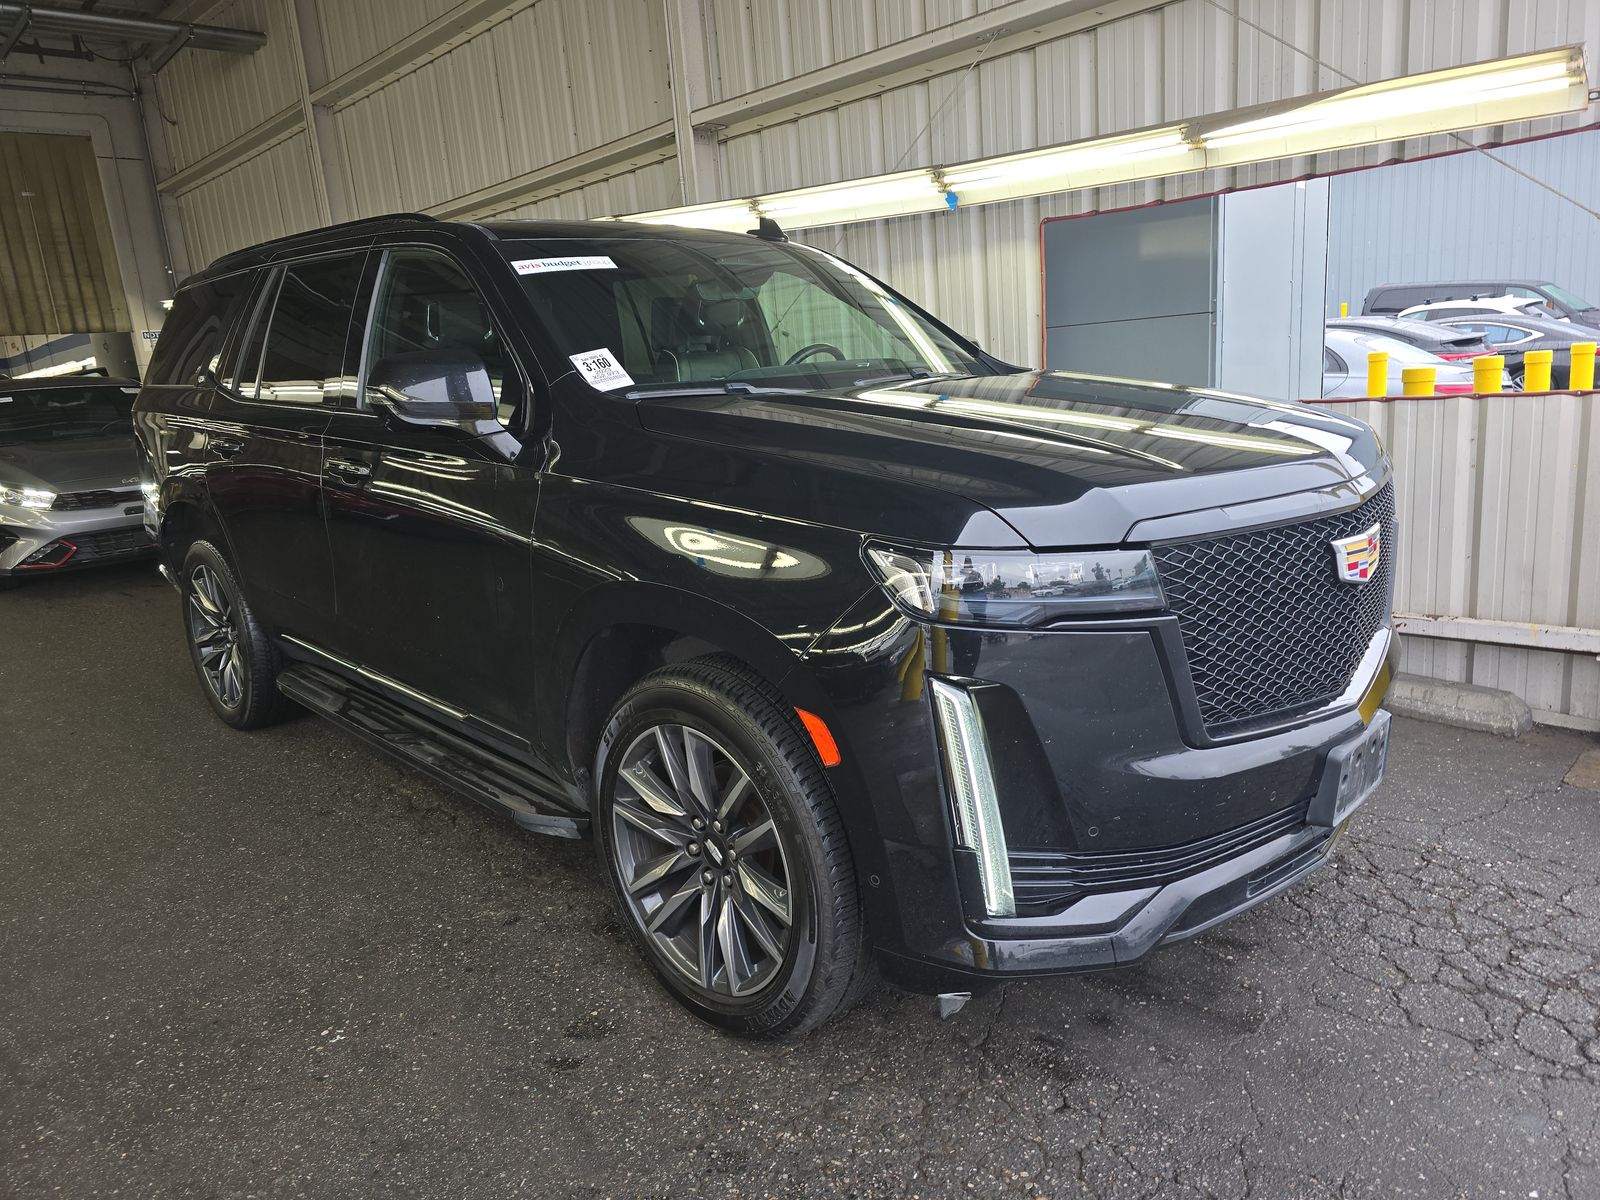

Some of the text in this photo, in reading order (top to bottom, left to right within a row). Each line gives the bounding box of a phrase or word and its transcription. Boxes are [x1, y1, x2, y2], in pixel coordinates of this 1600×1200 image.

[518, 262, 542, 271] avis
[541, 259, 583, 268] budget
[582, 357, 612, 372] 3:160
